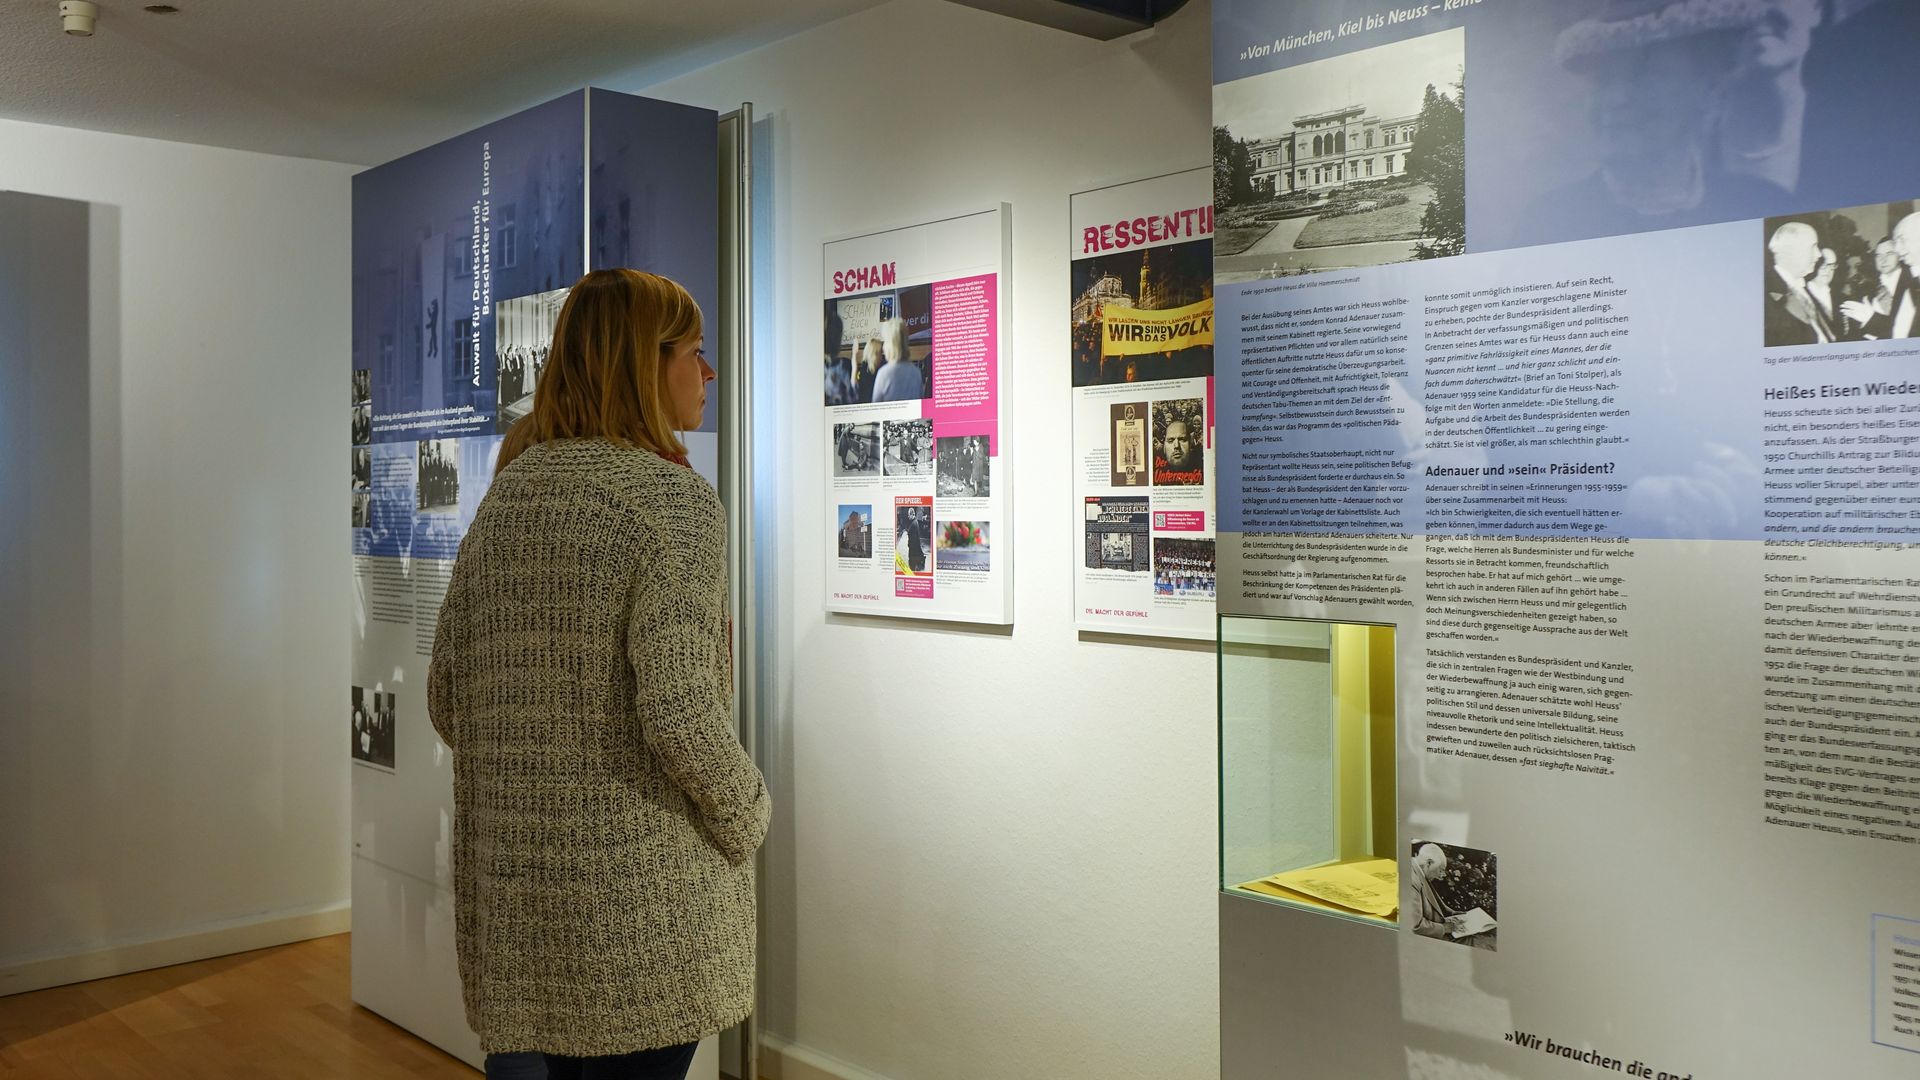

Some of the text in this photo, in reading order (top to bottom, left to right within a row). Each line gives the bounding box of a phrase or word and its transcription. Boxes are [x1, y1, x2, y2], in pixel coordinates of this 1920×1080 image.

[1240, 44, 1270, 61] »Von
[1273, 29, 1335, 54] München,
[1338, 18, 1363, 38] Kiel
[1366, 14, 1384, 31] bis
[1388, 5, 1428, 26] Neuss
[482, 142, 491, 196] Europa
[472, 200, 480, 300] Deutschland,
[833, 262, 896, 294] SCHAM
[1424, 276, 1614, 302] konnte somit unmöglich insistieren. Auf sein Recht,
[1241, 312, 1251, 321] Bei
[1251, 311, 1261, 320] der
[1262, 308, 1292, 321] Ausübung
[1293, 306, 1312, 316] seines
[1313, 304, 1334, 314] Amtes
[1347, 302, 1360, 311] sich
[1361, 300, 1381, 309] Heuss
[1424, 304, 1459, 316] Einspruch
[1460, 303, 1482, 313] gegen
[1501, 297, 1529, 308] Kanzler
[1531, 292, 1592, 307] vorgeschlagene
[1593, 288, 1627, 299] Minister
[1108, 324, 1144, 342] WIR
[1145, 326, 1167, 334] SIND
[1167, 316, 1212, 340] VOLK
[1424, 314, 1629, 339] In Anbetracht der verfassungsmäßigen und politischen
[1242, 369, 1408, 388] Mit Courage und Offenheit, mit Aufrichtigkeit, Toleranz
[1764, 386, 1816, 400] Heißes
[1820, 385, 1861, 398] Eisen
[1764, 405, 1897, 418] Heuss scheute sich bei aller
[1764, 435, 1919, 446] anzufassen. Als der Straßburger
[1155, 456, 1168, 468] Der
[1426, 464, 1479, 476] Adenauer
[1483, 464, 1505, 476] und
[1550, 462, 1615, 475] Präsident?
[1764, 481, 1792, 489] Heuss
[1823, 481, 1863, 490] Skrupel,
[1890, 481, 1919, 489] unter
[1463, 496, 1525, 504] Zusammenarbeit
[1764, 574, 1904, 586] Schon im Parlamentarischen
[1427, 648, 1465, 659] Tatsächlich
[1466, 651, 1507, 662] verstanden
[1518, 655, 1582, 669] Bundespräsident
[1584, 660, 1600, 669] und
[1601, 661, 1633, 673] Kanzler,
[1426, 745, 1454, 756] matiker
[1455, 748, 1491, 762] Adenauer,
[1492, 753, 1518, 764] dessen
[1539, 758, 1574, 772] sieghafte
[1504, 1031, 1543, 1050] »Wir
[1546, 1038, 1622, 1072] brauchen
[1626, 1060, 1652, 1079] die
